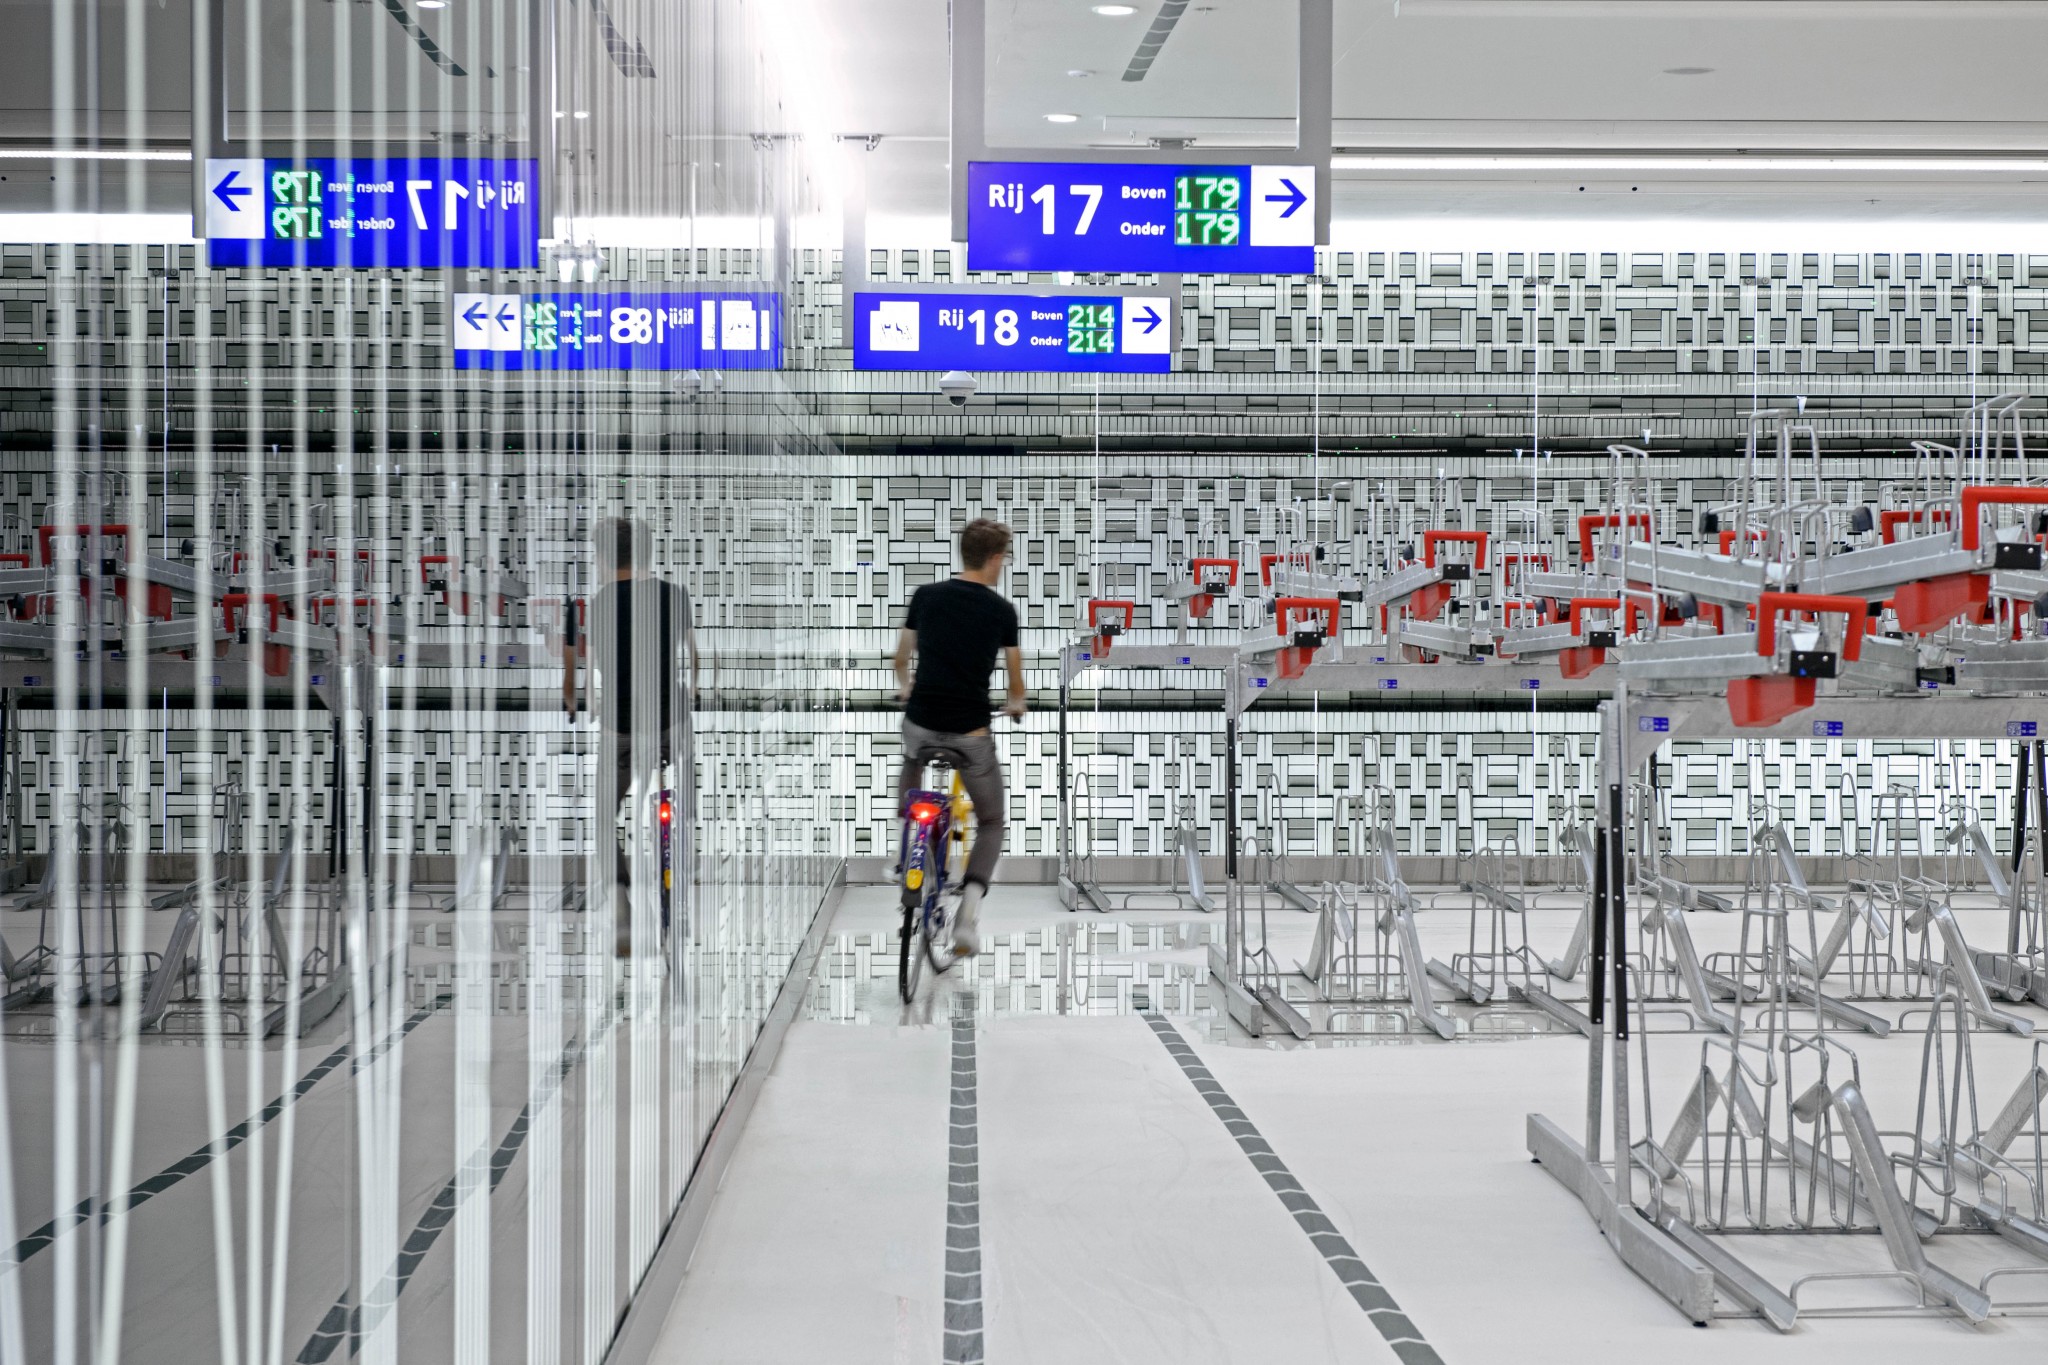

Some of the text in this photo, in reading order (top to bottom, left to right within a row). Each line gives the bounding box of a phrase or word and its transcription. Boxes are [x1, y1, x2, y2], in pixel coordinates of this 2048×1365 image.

[989, 184, 1103, 235] Rij 17
[1121, 177, 1240, 210] Boven 179
[1120, 212, 1240, 245] Onder 179
[938, 309, 1019, 346] Rij 18
[1031, 304, 1115, 329] Boven 214
[1030, 330, 1115, 354] Onder 214
